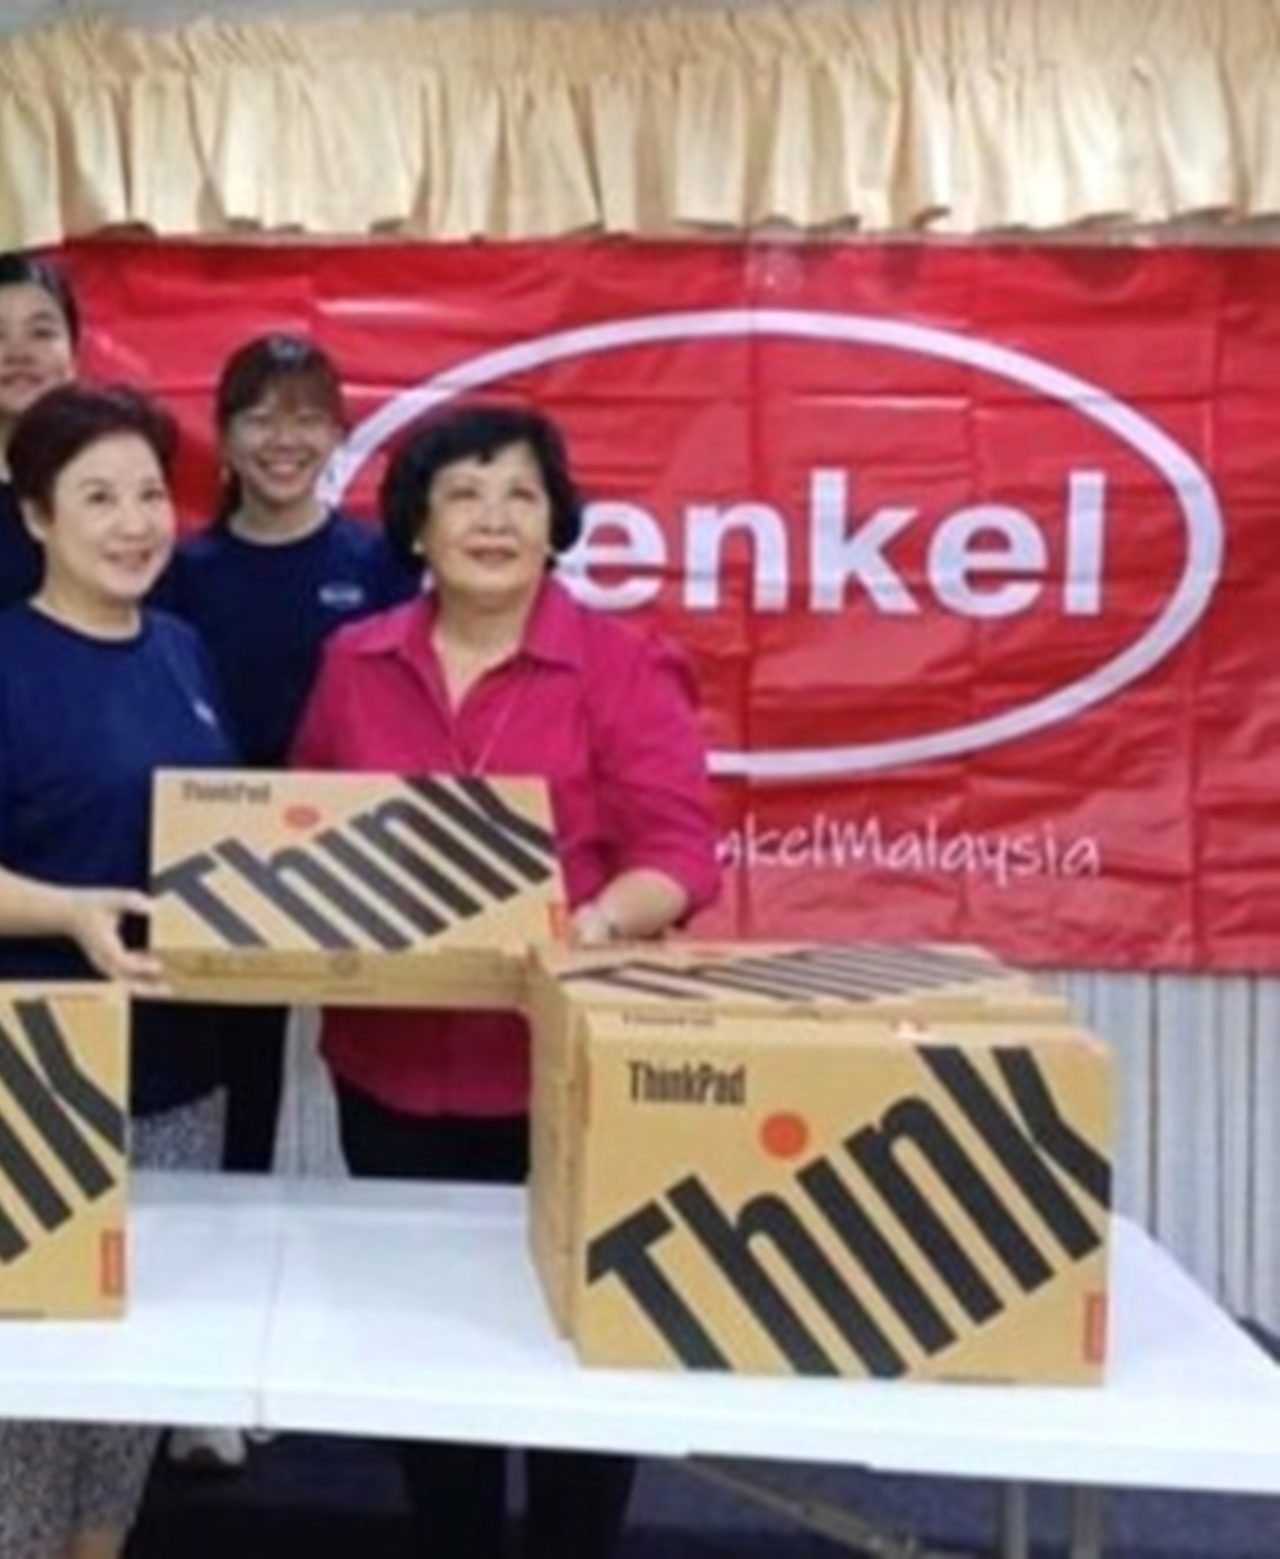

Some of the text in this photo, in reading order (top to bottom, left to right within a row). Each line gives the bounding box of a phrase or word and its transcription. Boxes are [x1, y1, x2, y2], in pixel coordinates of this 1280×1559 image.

[552, 467, 1104, 617] enkel
[152, 775, 554, 951] Think
[715, 812, 1101, 887] nkelMalaysia
[628, 1060, 745, 1106] ThinkPad
[587, 1046, 1111, 1377] Think
